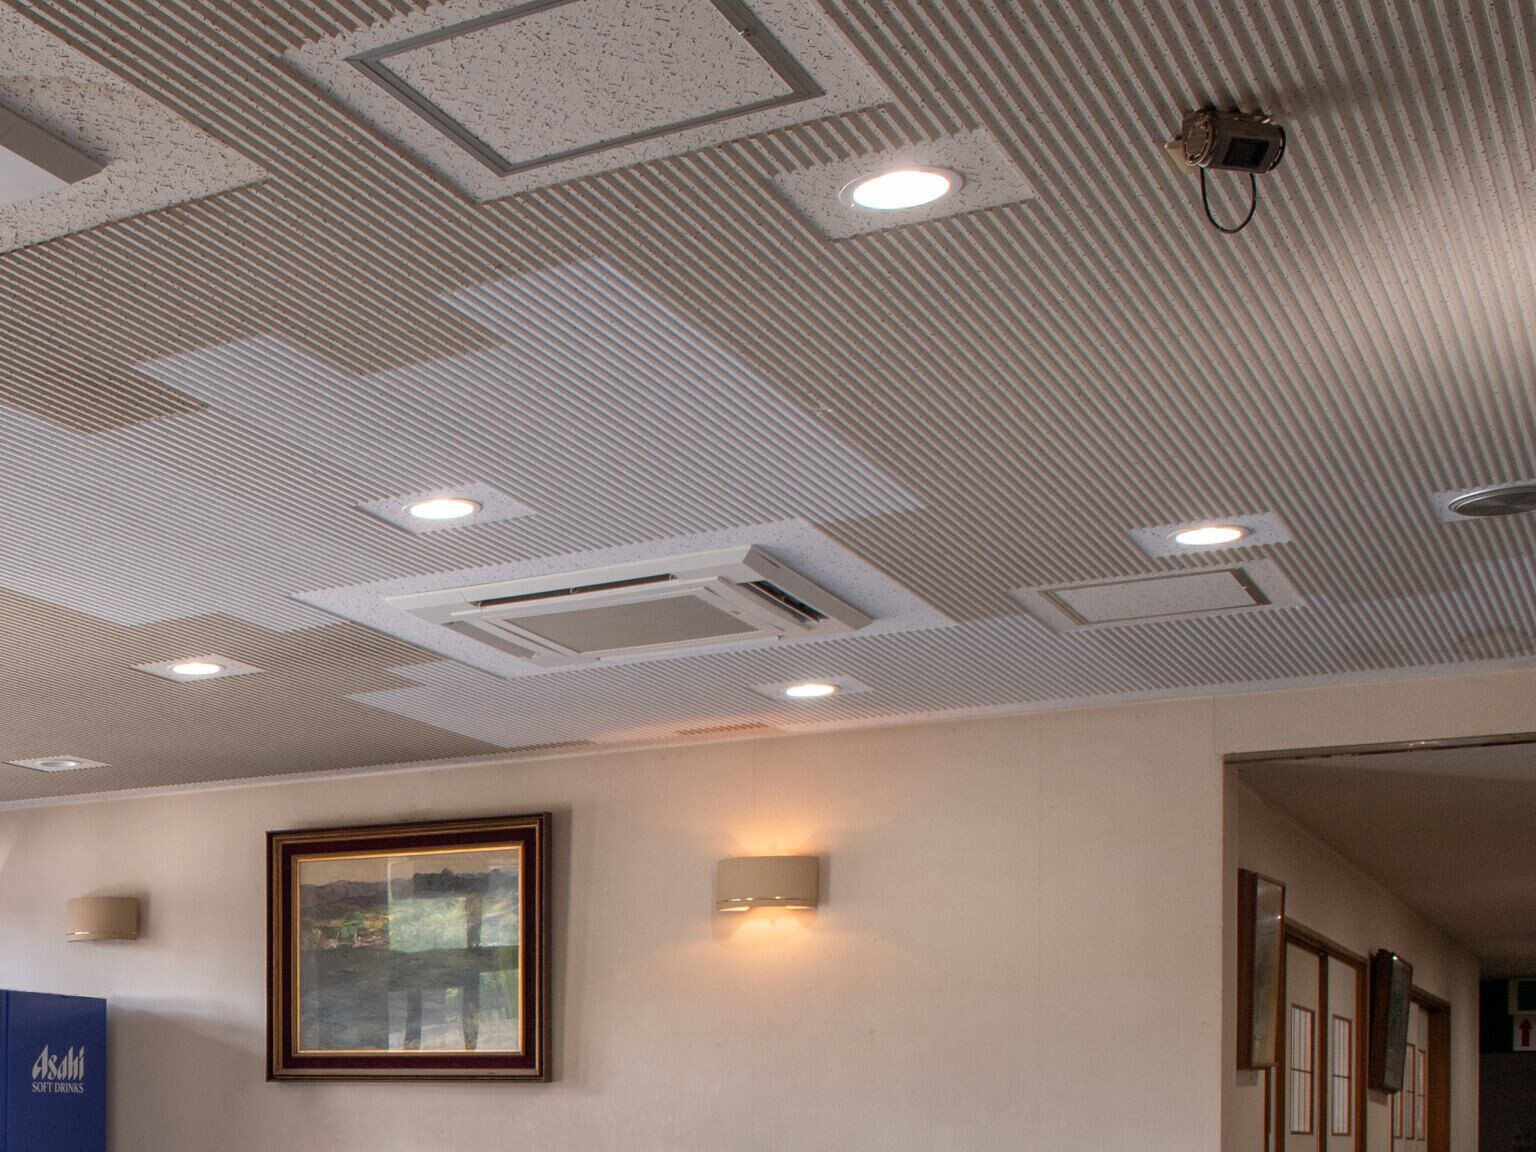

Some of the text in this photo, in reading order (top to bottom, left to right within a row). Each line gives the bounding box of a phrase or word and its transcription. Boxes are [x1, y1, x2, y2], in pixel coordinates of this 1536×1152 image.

[31, 1044, 85, 1081] Asahi
[31, 1081, 84, 1094] SOFT DRINKS
